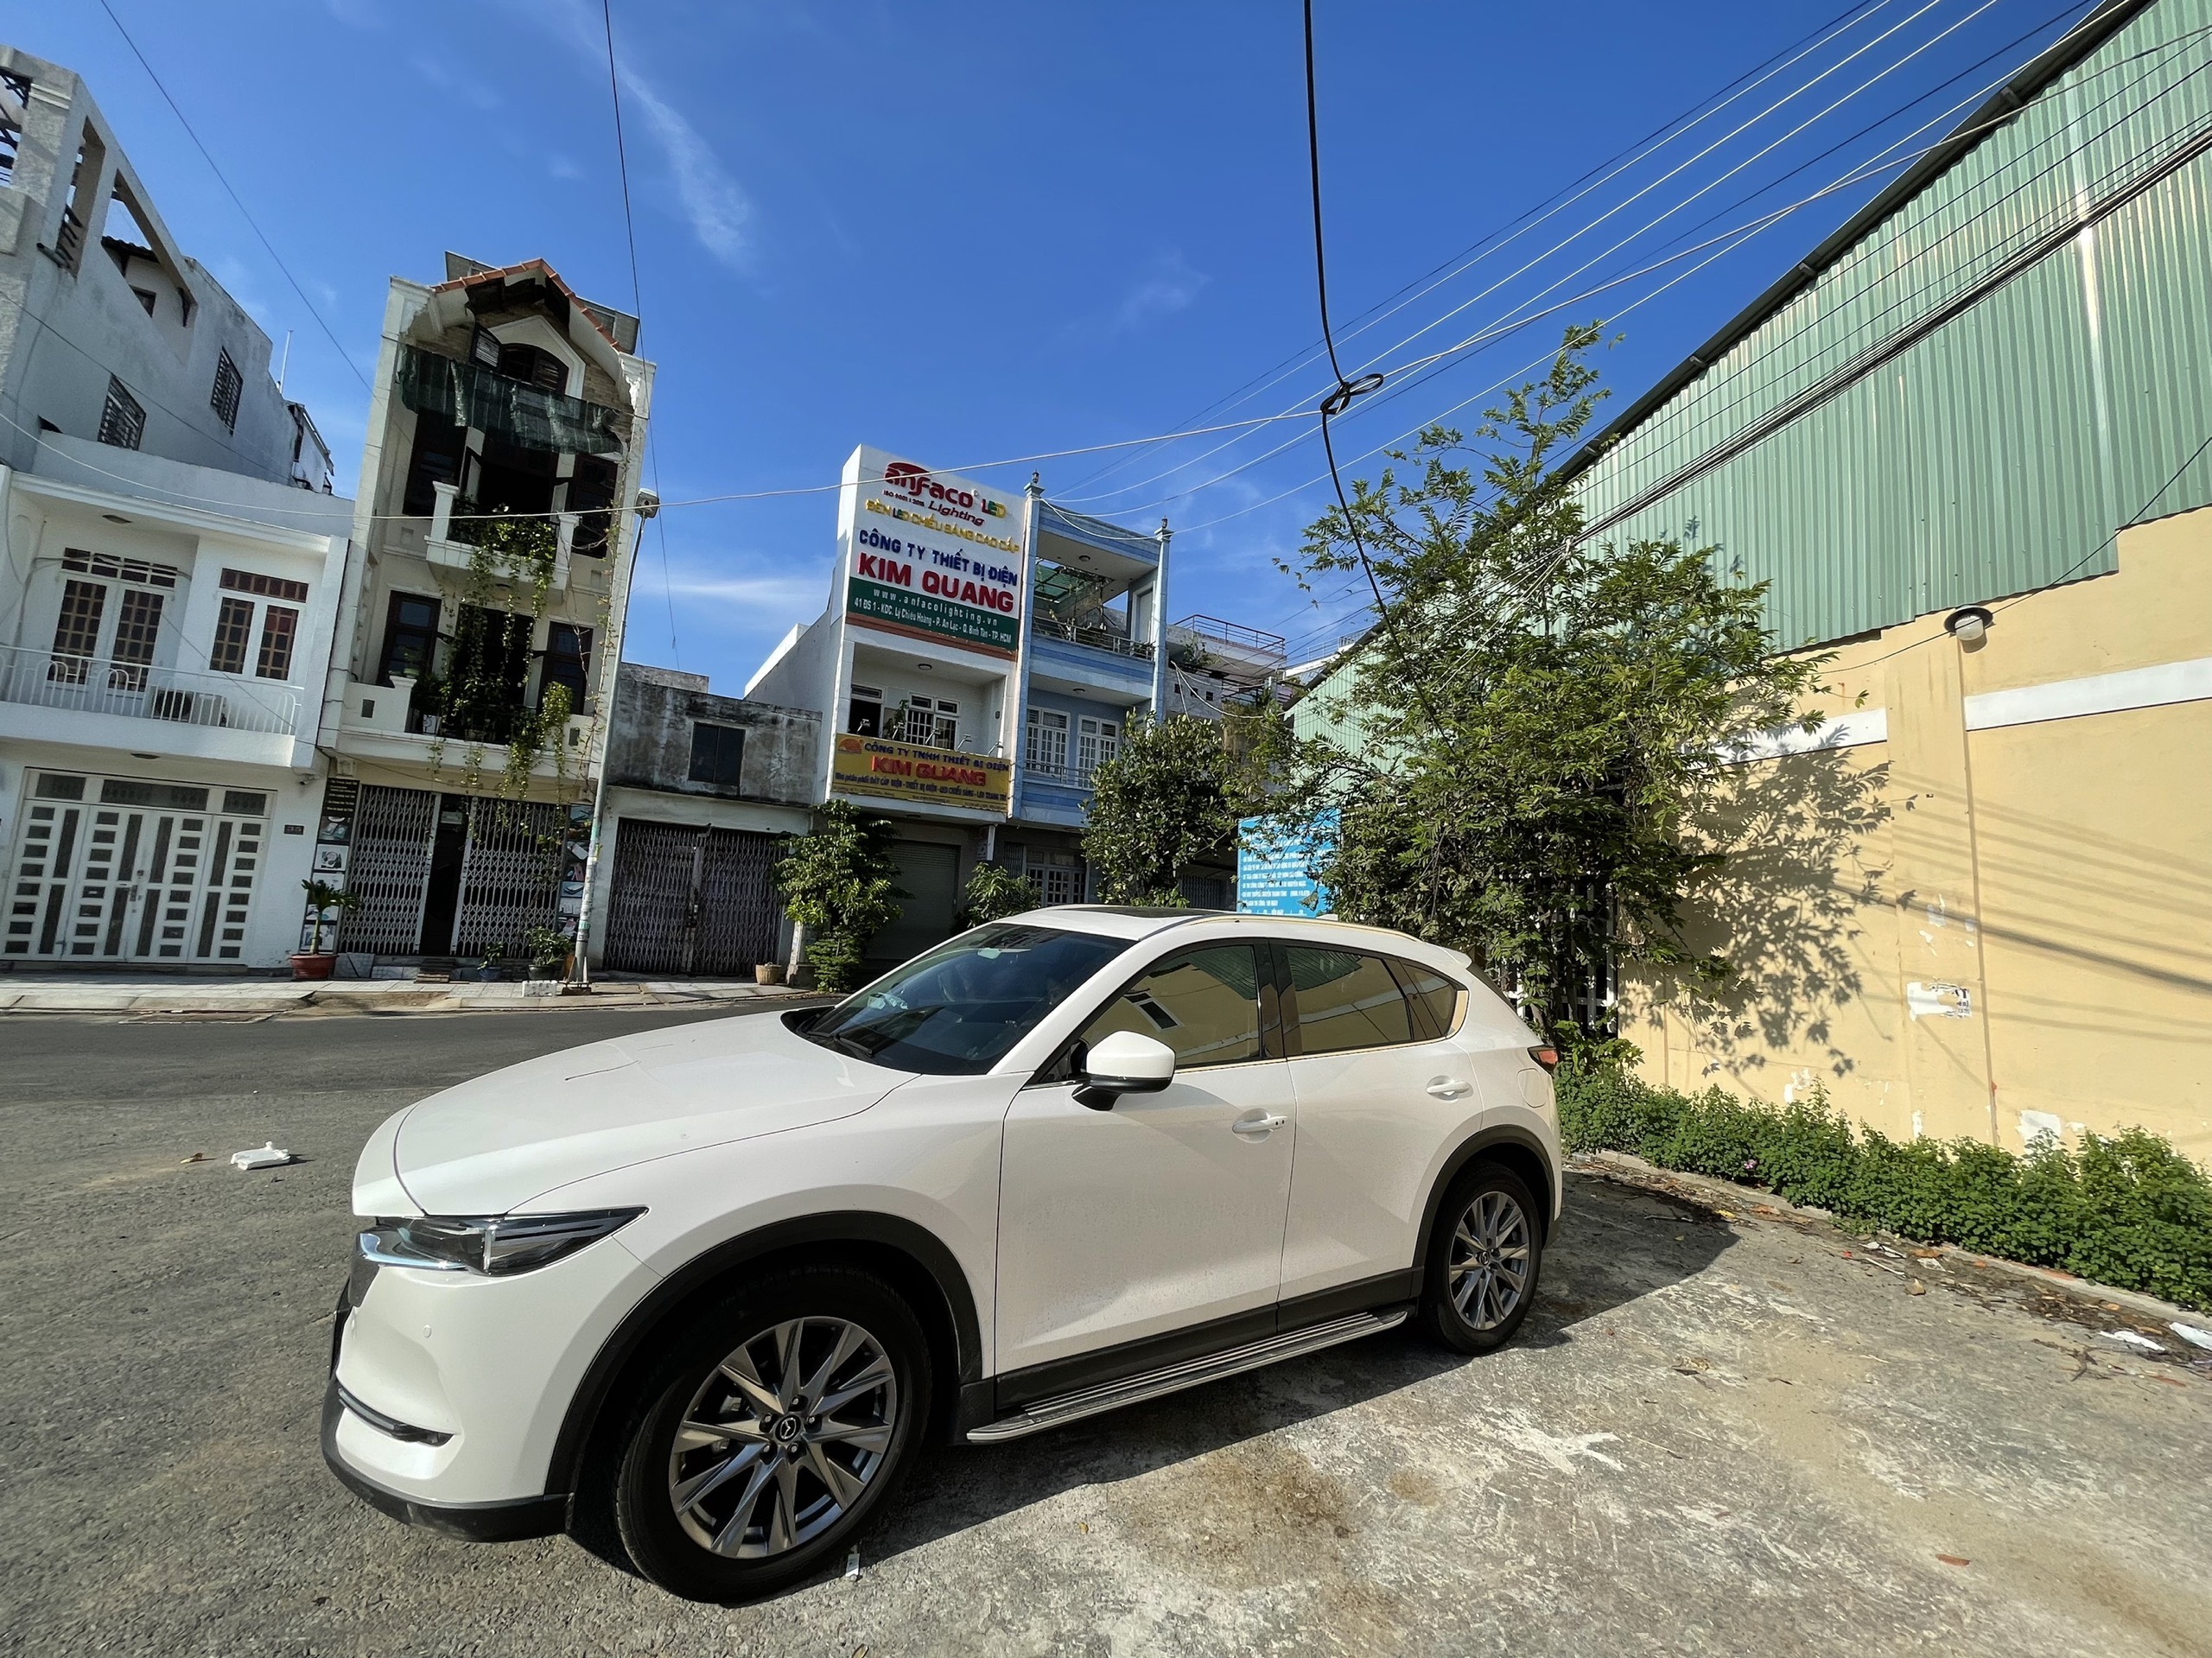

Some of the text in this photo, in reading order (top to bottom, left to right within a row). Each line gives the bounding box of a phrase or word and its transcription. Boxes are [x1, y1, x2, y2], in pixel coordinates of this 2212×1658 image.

[882, 489, 894, 498] ISO
[928, 500, 985, 526] Lighting
[885, 465, 1007, 518] anfaco LED
[893, 507, 910, 521] LED
[859, 528, 1018, 588] CÔNG TY THIẾT BỊ ĐIỆN
[858, 552, 1014, 613] KIM QUANG
[854, 597, 862, 608] 41
[864, 741, 893, 754] CÔNG
[898, 748, 910, 757] TY
[912, 750, 940, 761] TNHH
[943, 755, 970, 766] THIẾT
[872, 755, 987, 786] KIM QUANG
